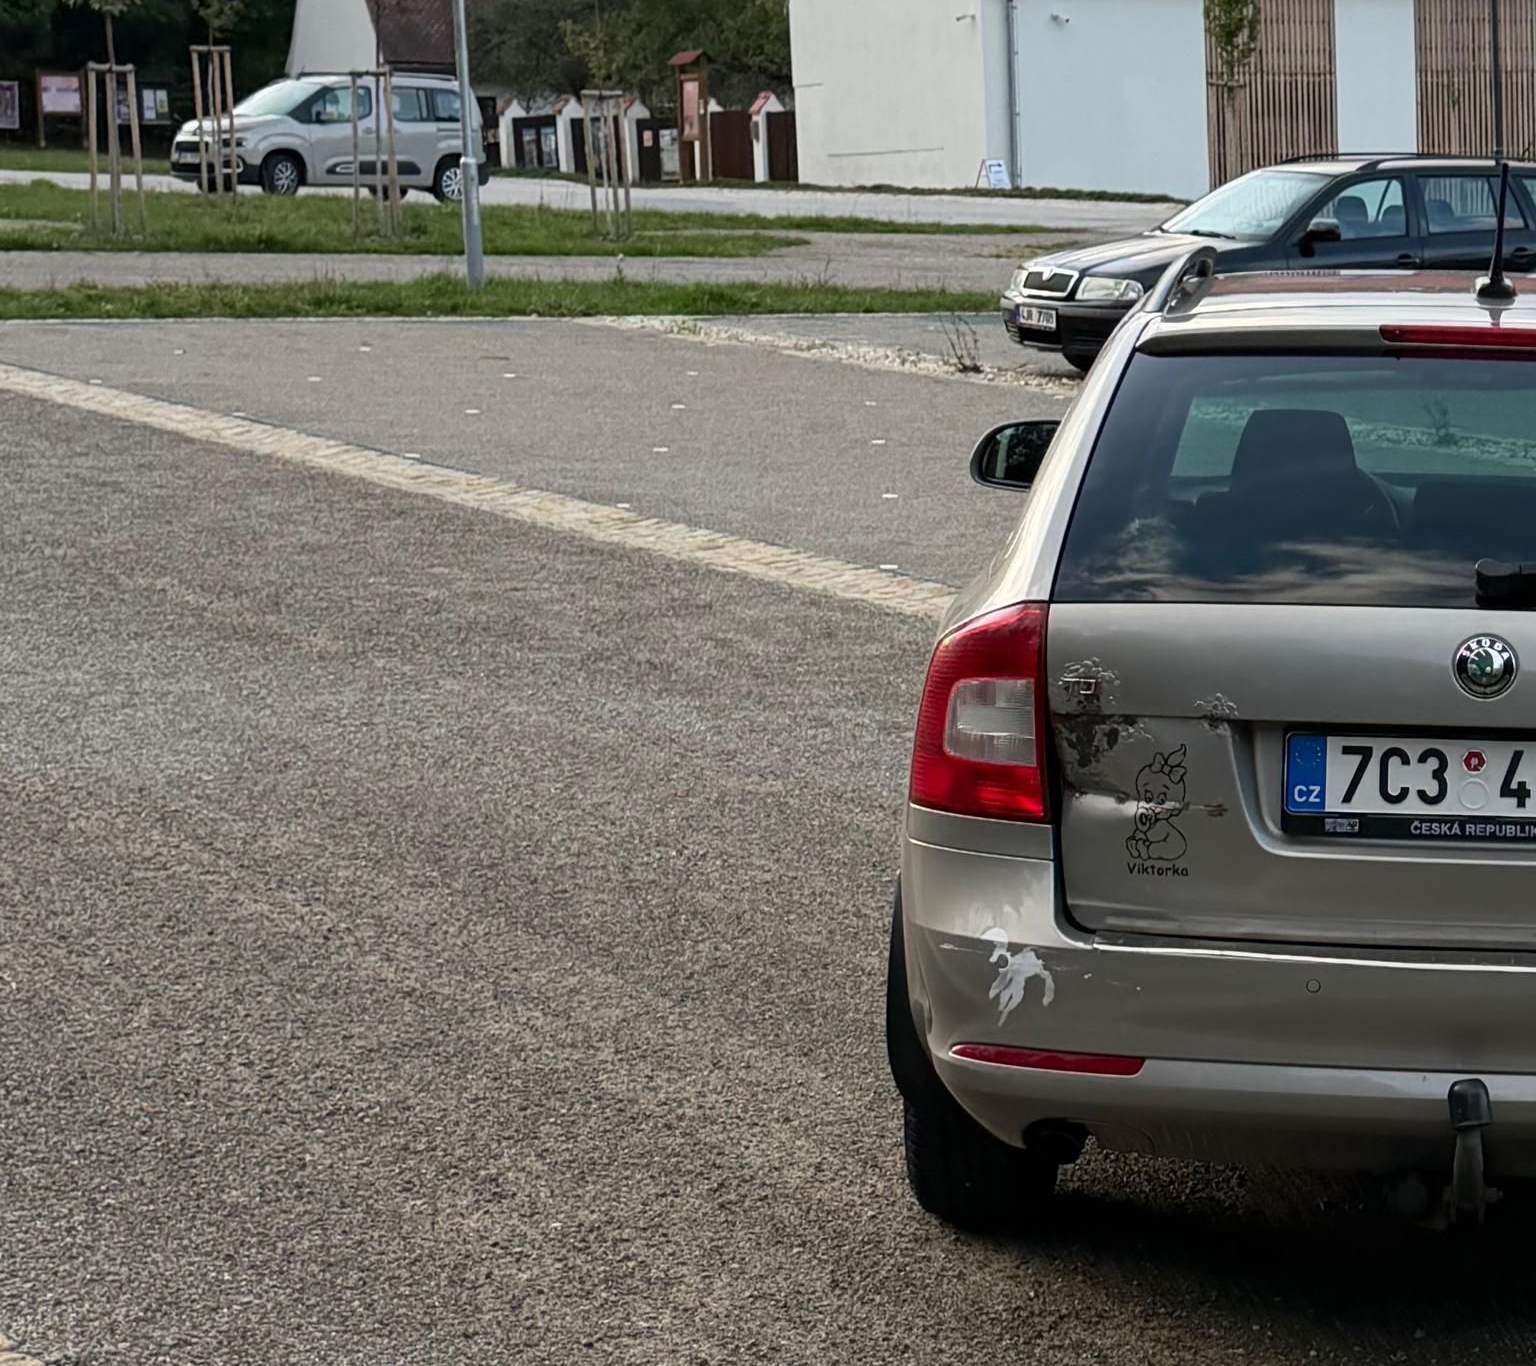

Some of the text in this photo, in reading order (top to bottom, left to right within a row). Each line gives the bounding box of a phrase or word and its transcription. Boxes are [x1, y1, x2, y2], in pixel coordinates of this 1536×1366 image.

[1341, 745, 1449, 805] 7C3
[1293, 785, 1321, 803] CZ
[1410, 819, 1462, 836] ČESKÁ
[1127, 862, 1189, 876] Viktorka
